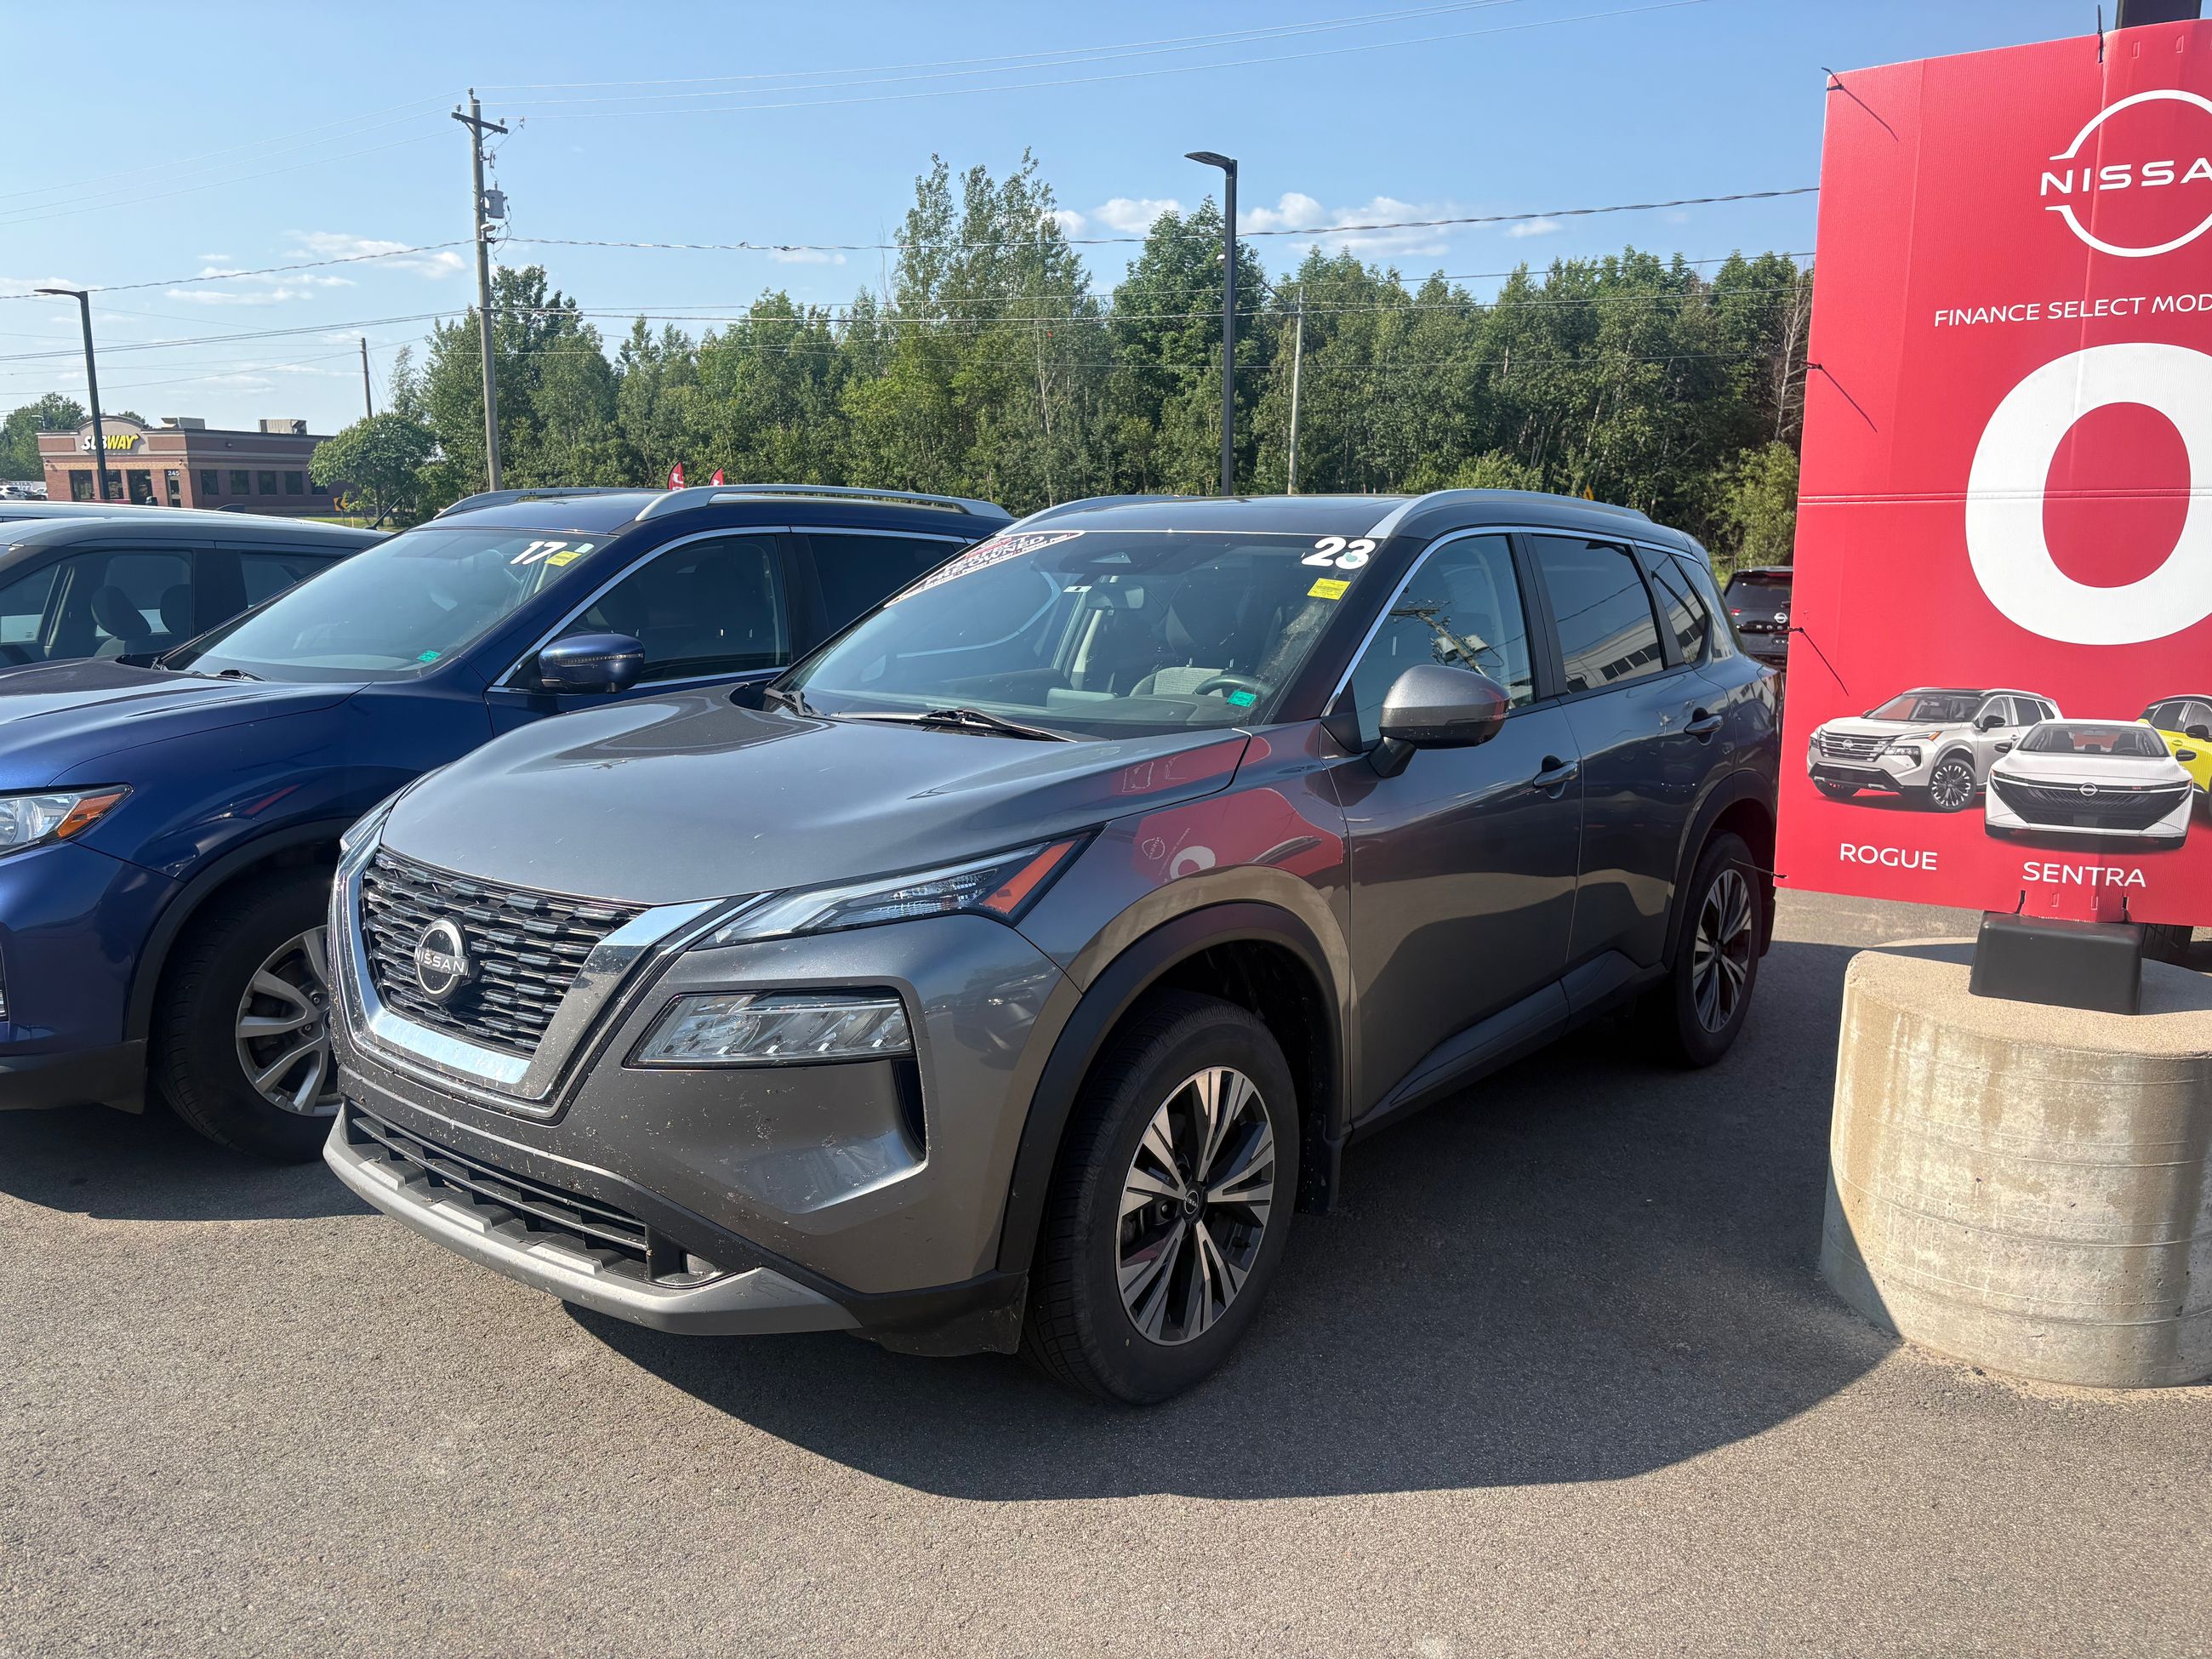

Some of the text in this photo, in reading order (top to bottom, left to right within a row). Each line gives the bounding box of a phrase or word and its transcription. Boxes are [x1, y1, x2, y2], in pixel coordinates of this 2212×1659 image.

[1934, 303, 2041, 328] FINANCE
[2047, 296, 2146, 320] SELECT
[510, 540, 568, 565] 17
[1301, 536, 1377, 570] 23
[1839, 842, 1938, 871] ROGUE
[2022, 861, 2146, 888] SENTRA
[413, 946, 465, 973] NISSAN
